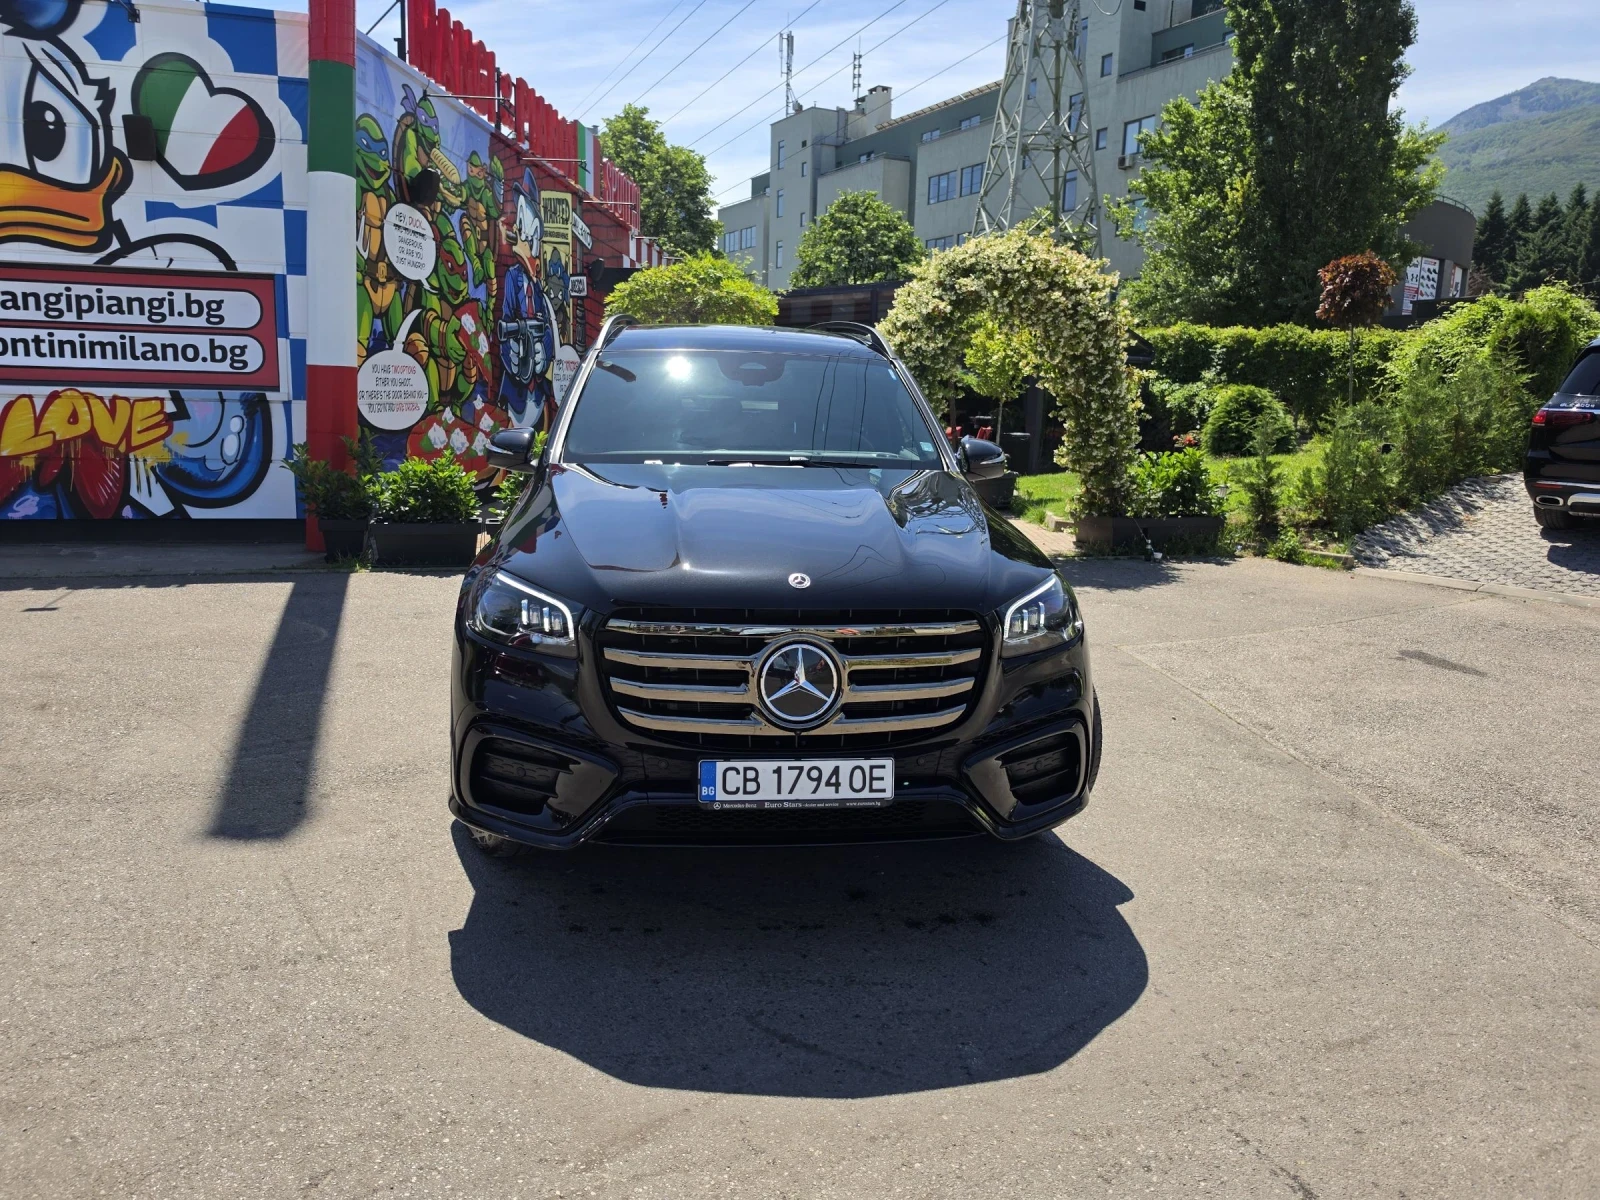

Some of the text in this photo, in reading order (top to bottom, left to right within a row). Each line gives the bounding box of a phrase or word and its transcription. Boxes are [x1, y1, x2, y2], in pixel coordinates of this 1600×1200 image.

[0, 286, 225, 326] angipiangi.bg
[0, 388, 174, 457] LOVE
[701, 786, 715, 796] BG
[722, 766, 761, 795] CB
[772, 765, 841, 795] 1794
